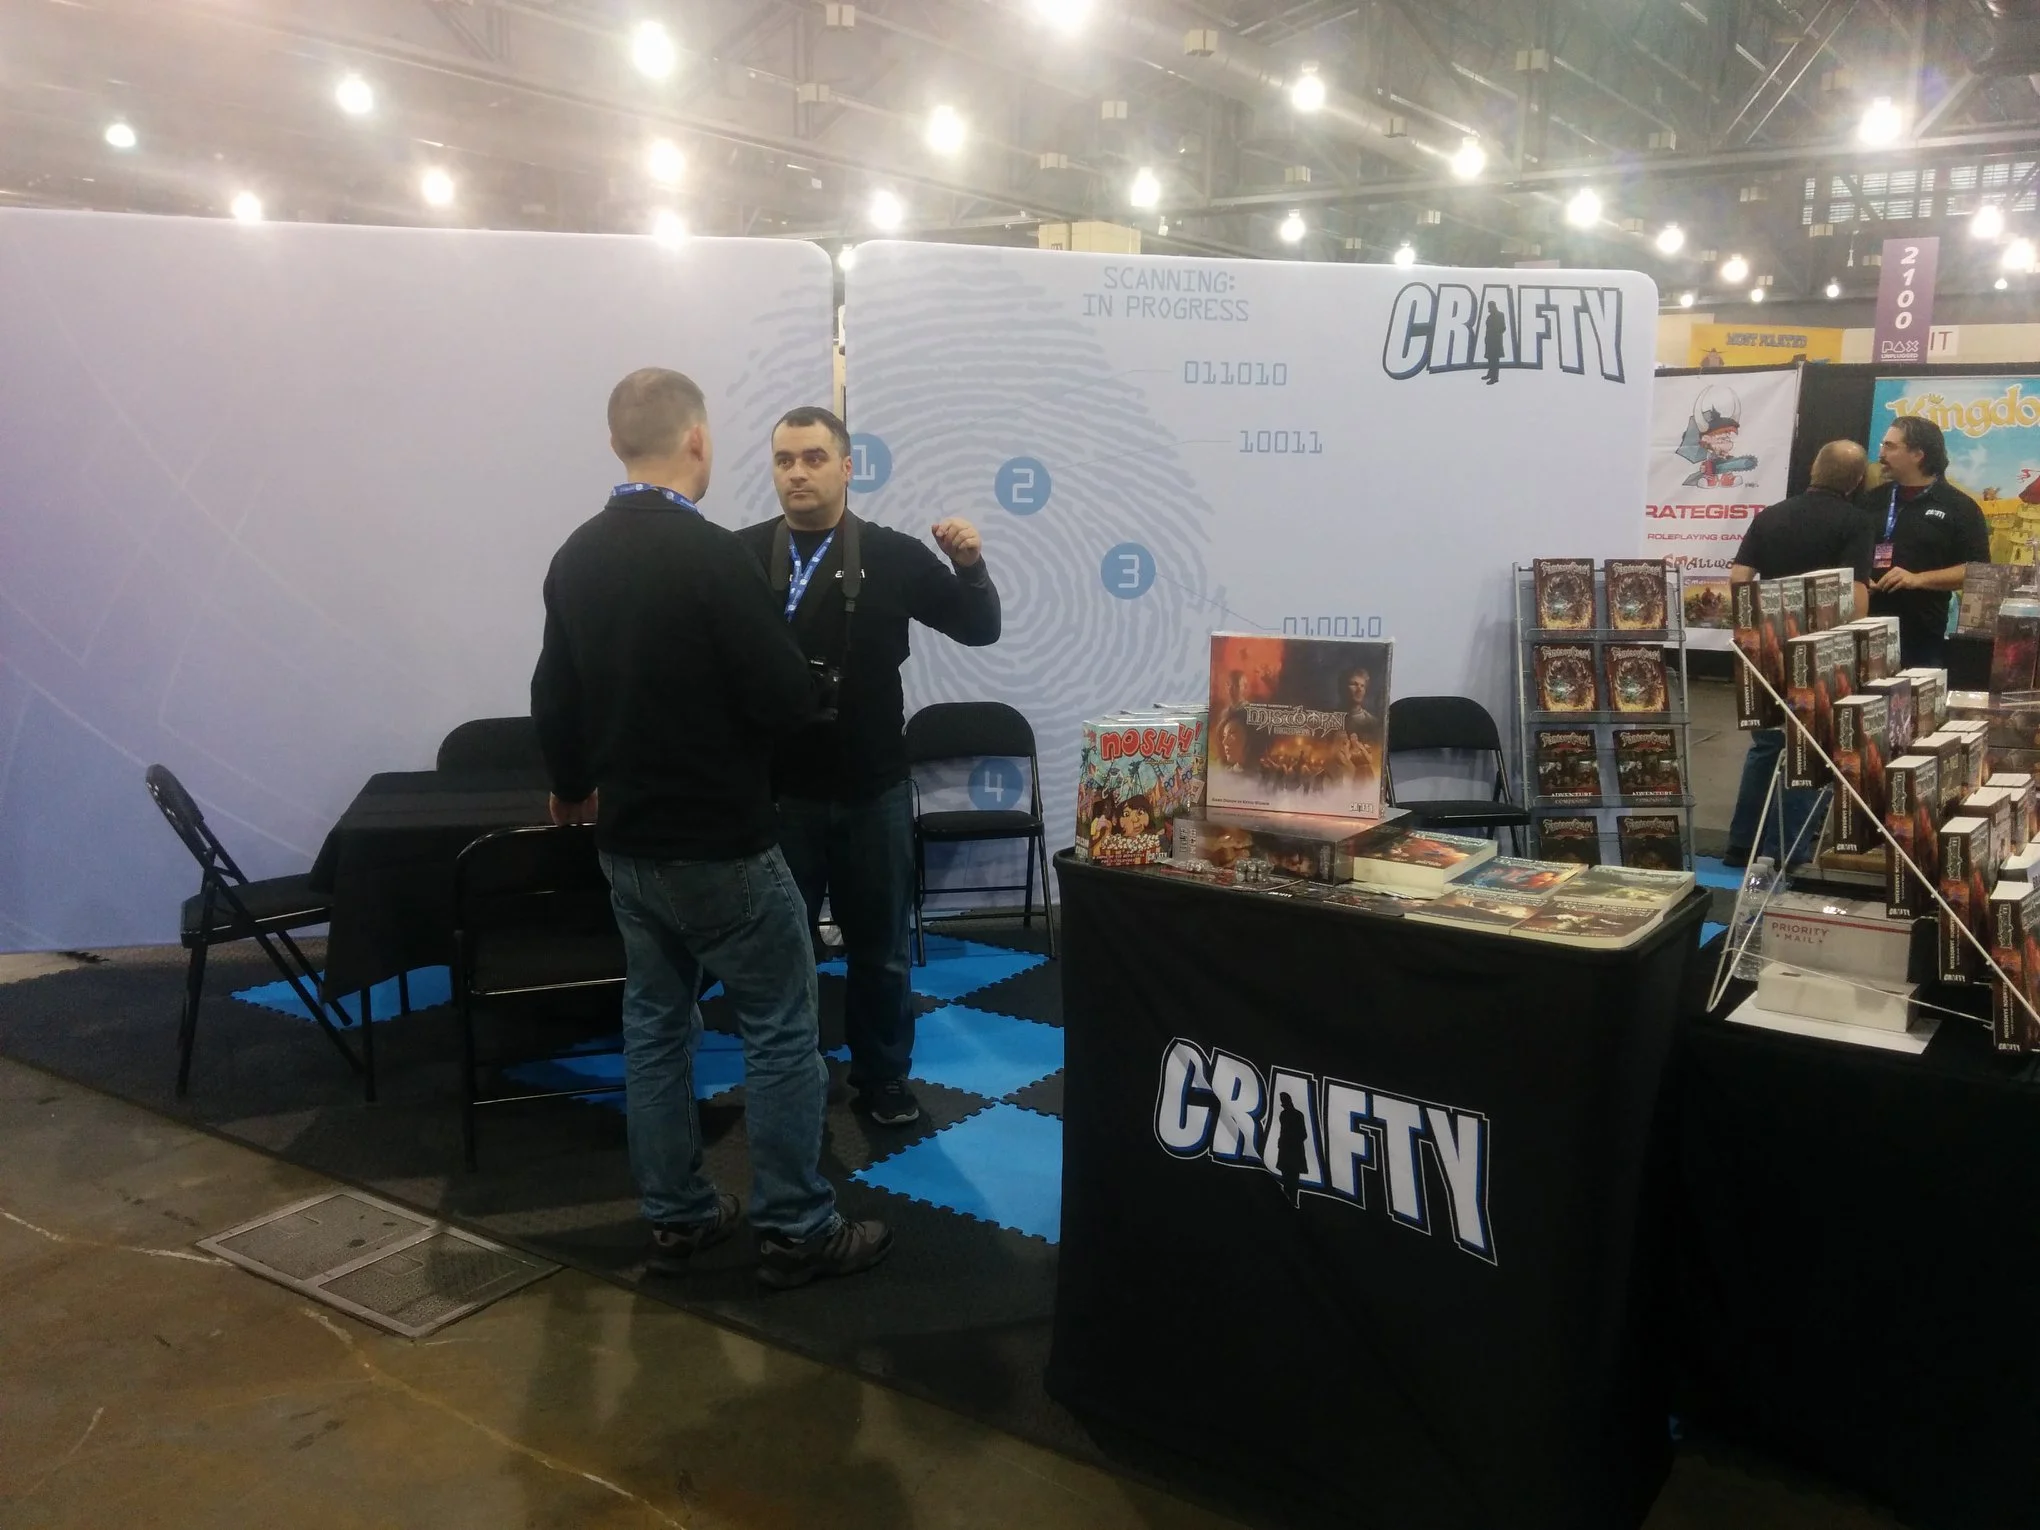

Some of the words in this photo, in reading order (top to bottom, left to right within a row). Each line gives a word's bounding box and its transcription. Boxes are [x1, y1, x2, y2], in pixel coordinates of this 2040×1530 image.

[1104, 266, 1235, 293] SCANNING:
[1894, 246, 1919, 329] 2100
[1082, 293, 1113, 318] IN
[1126, 295, 1250, 322] PROGRESS
[1382, 281, 1626, 385] CRAFTY
[1881, 340, 1920, 353] PAX
[1184, 360, 1288, 386] 011010
[1239, 430, 1323, 454] 10011
[1012, 467, 1035, 504] 2
[1647, 533, 1718, 541] ROLEPLAYING
[1117, 554, 1140, 588] 3
[1283, 616, 1381, 638] 010010
[984, 770, 1003, 803] 4
[1772, 922, 1829, 937] PRIORITY
[1784, 934, 1814, 944] MAIL
[1154, 1037, 1498, 1266] CRAFTY
